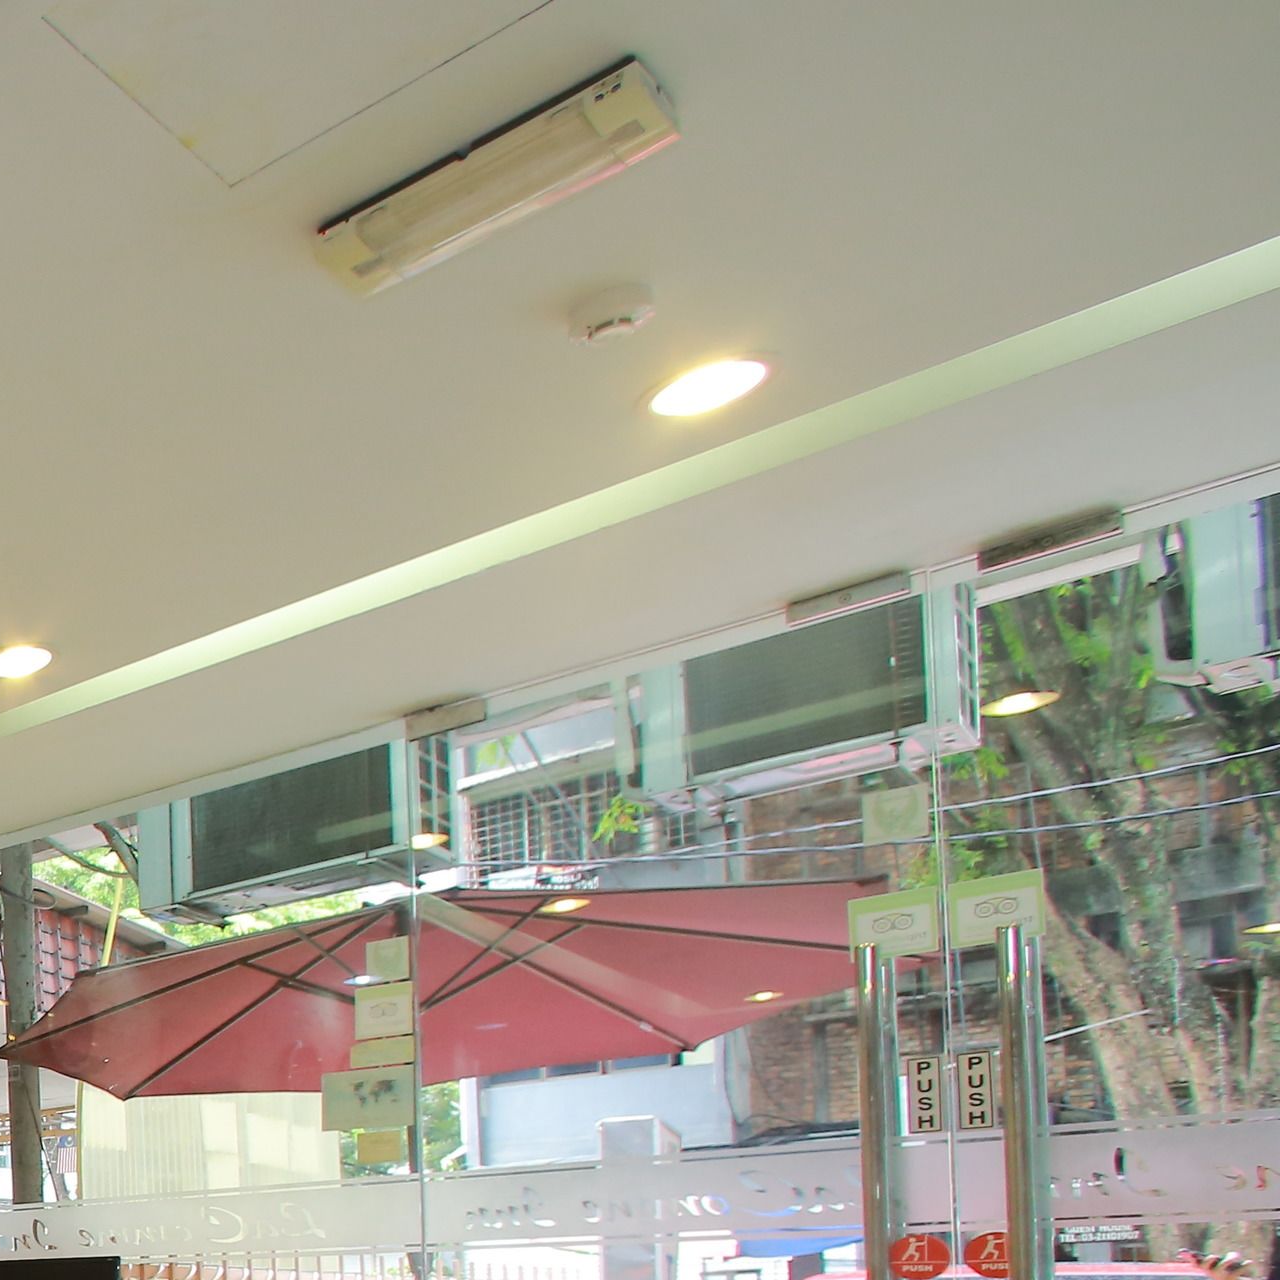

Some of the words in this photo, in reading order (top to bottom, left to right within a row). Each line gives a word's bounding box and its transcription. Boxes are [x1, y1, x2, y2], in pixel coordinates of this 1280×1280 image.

[917, 1061, 933, 1129] PUSH
[968, 1056, 985, 1125] PUSH
[902, 1264, 933, 1272] PUSH
